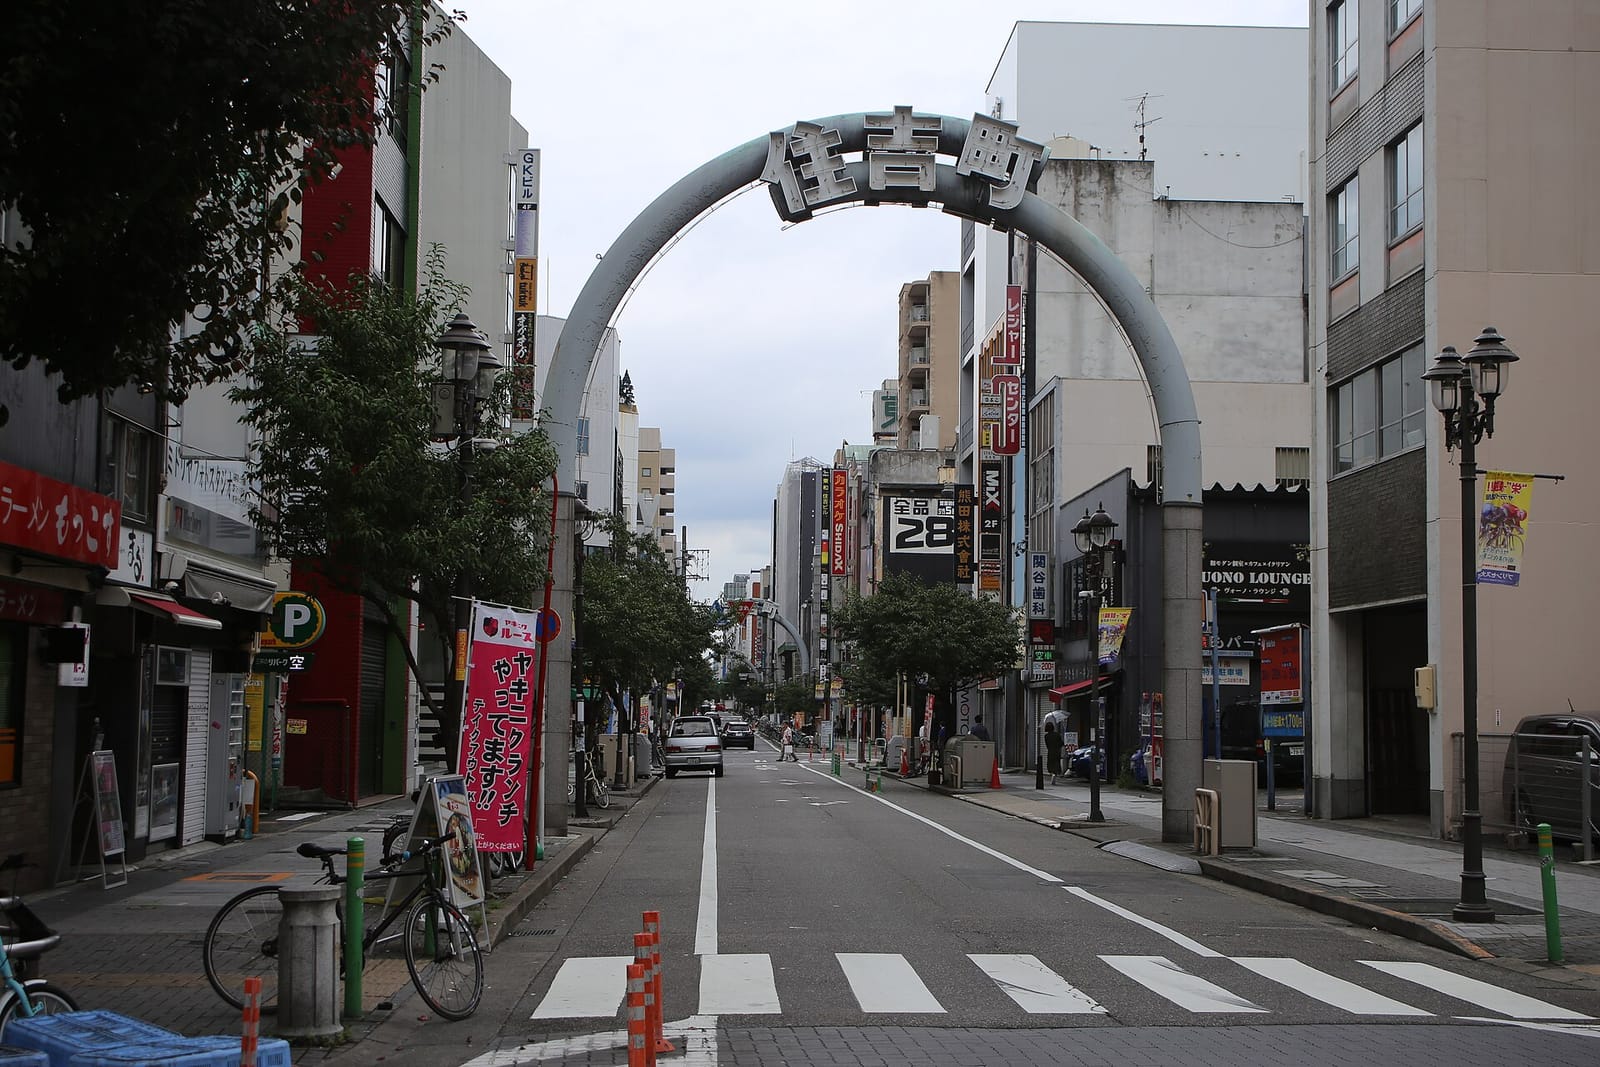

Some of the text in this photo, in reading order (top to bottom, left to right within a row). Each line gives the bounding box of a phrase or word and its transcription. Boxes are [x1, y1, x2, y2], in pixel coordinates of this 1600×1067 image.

[522, 153, 534, 198] GKビル
[760, 105, 1045, 214] 住吉町
[1007, 298, 1020, 443] レジャー センター
[894, 499, 929, 515] 全品
[986, 470, 1000, 507] MIX
[1, 486, 50, 532] ラーメン
[55, 494, 115, 558] もっこす
[834, 474, 846, 571] カラオケ SHIDAX
[984, 519, 998, 528] 2F
[1033, 555, 1046, 615] 関谷歯科
[284, 604, 311, 638] P
[501, 628, 534, 643] ルース
[289, 655, 305, 669] 空
[497, 651, 533, 827] ヤキニクランチ
